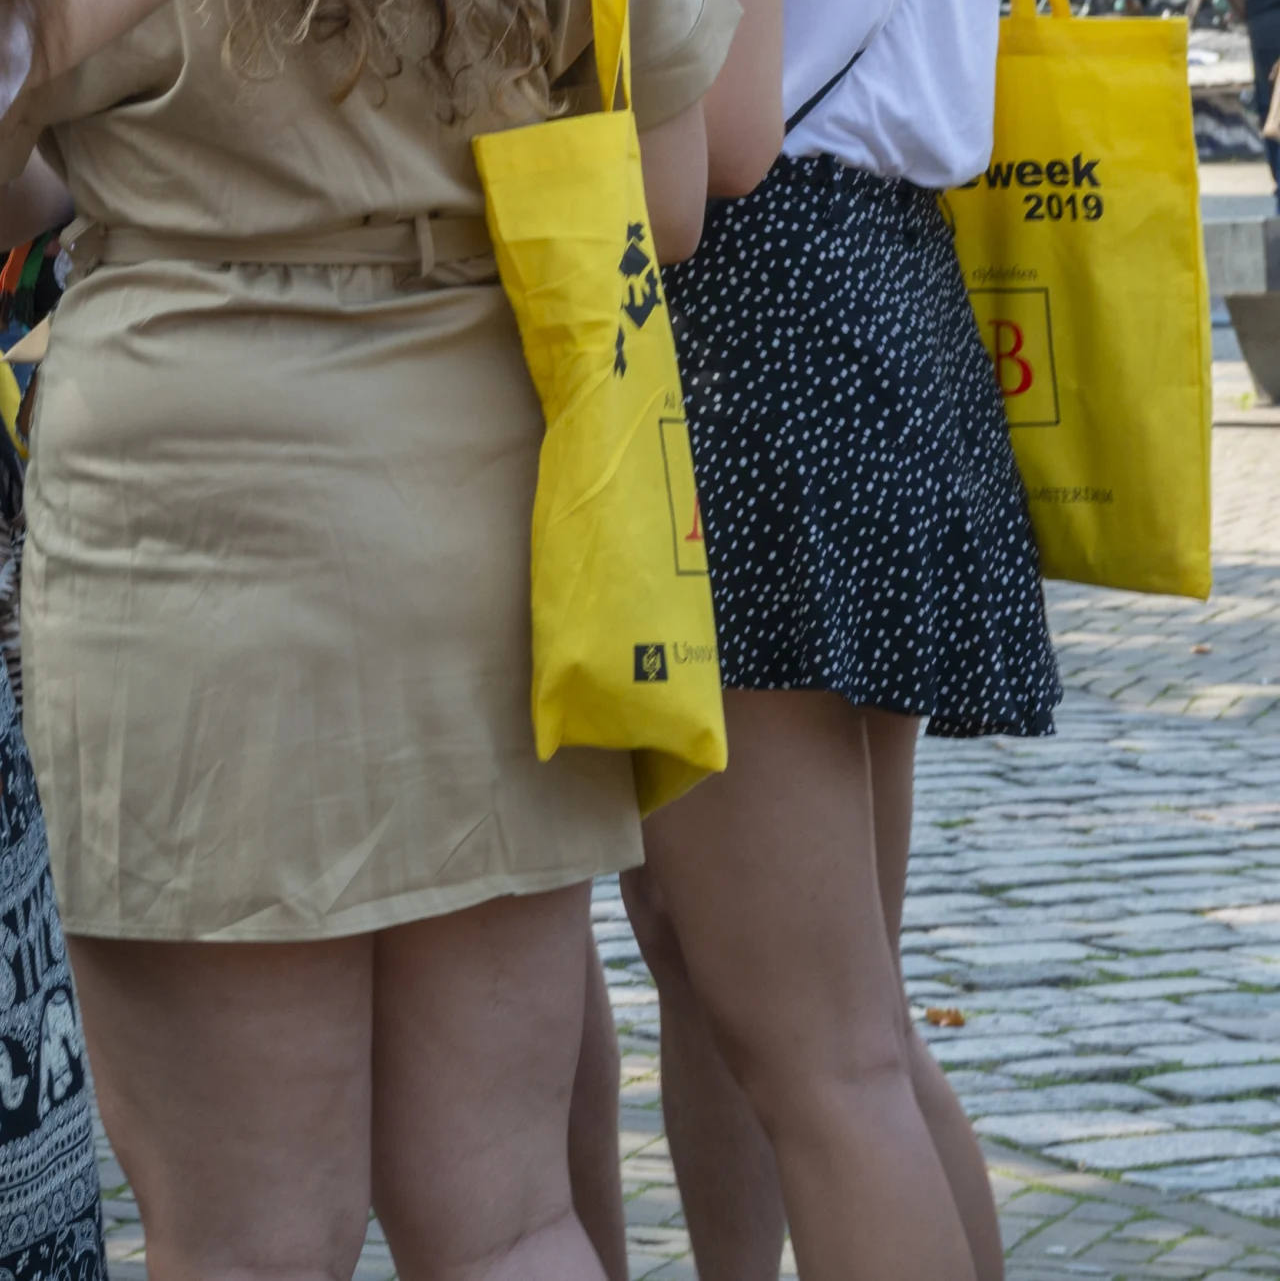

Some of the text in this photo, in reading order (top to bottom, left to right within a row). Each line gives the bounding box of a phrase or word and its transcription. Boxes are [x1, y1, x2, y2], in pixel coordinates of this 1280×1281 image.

[956, 151, 1102, 190] week
[1022, 192, 1104, 223] 2019
[987, 318, 1034, 398] B
